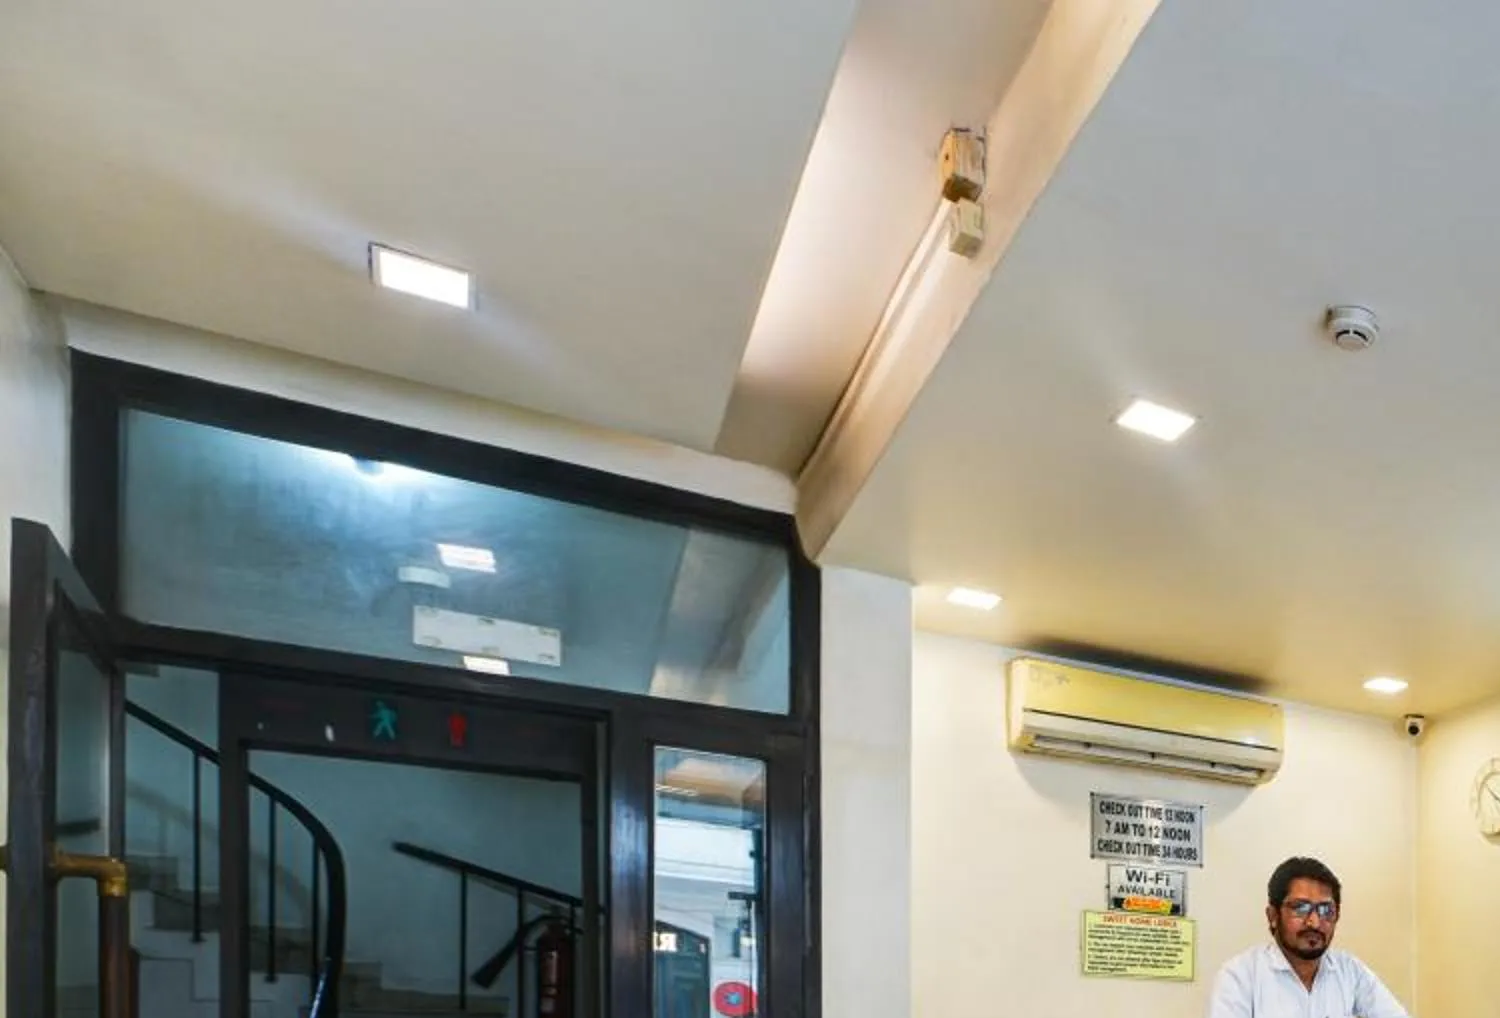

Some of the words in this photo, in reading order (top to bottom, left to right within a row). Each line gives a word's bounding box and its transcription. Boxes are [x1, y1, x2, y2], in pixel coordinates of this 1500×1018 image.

[1100, 801, 1126, 816] CHECK
[1127, 804, 1142, 818] OUT
[1144, 806, 1162, 820] TIME
[1105, 820, 1111, 833] 7
[1114, 822, 1129, 834] AM
[1132, 824, 1145, 837] TO
[1149, 825, 1160, 838] 12
[1162, 827, 1190, 842] NOON
[1098, 839, 1124, 854] CHECK
[1126, 841, 1141, 856] OUT
[1143, 843, 1160, 856] TIME
[1126, 870, 1170, 886] Wi-Fi
